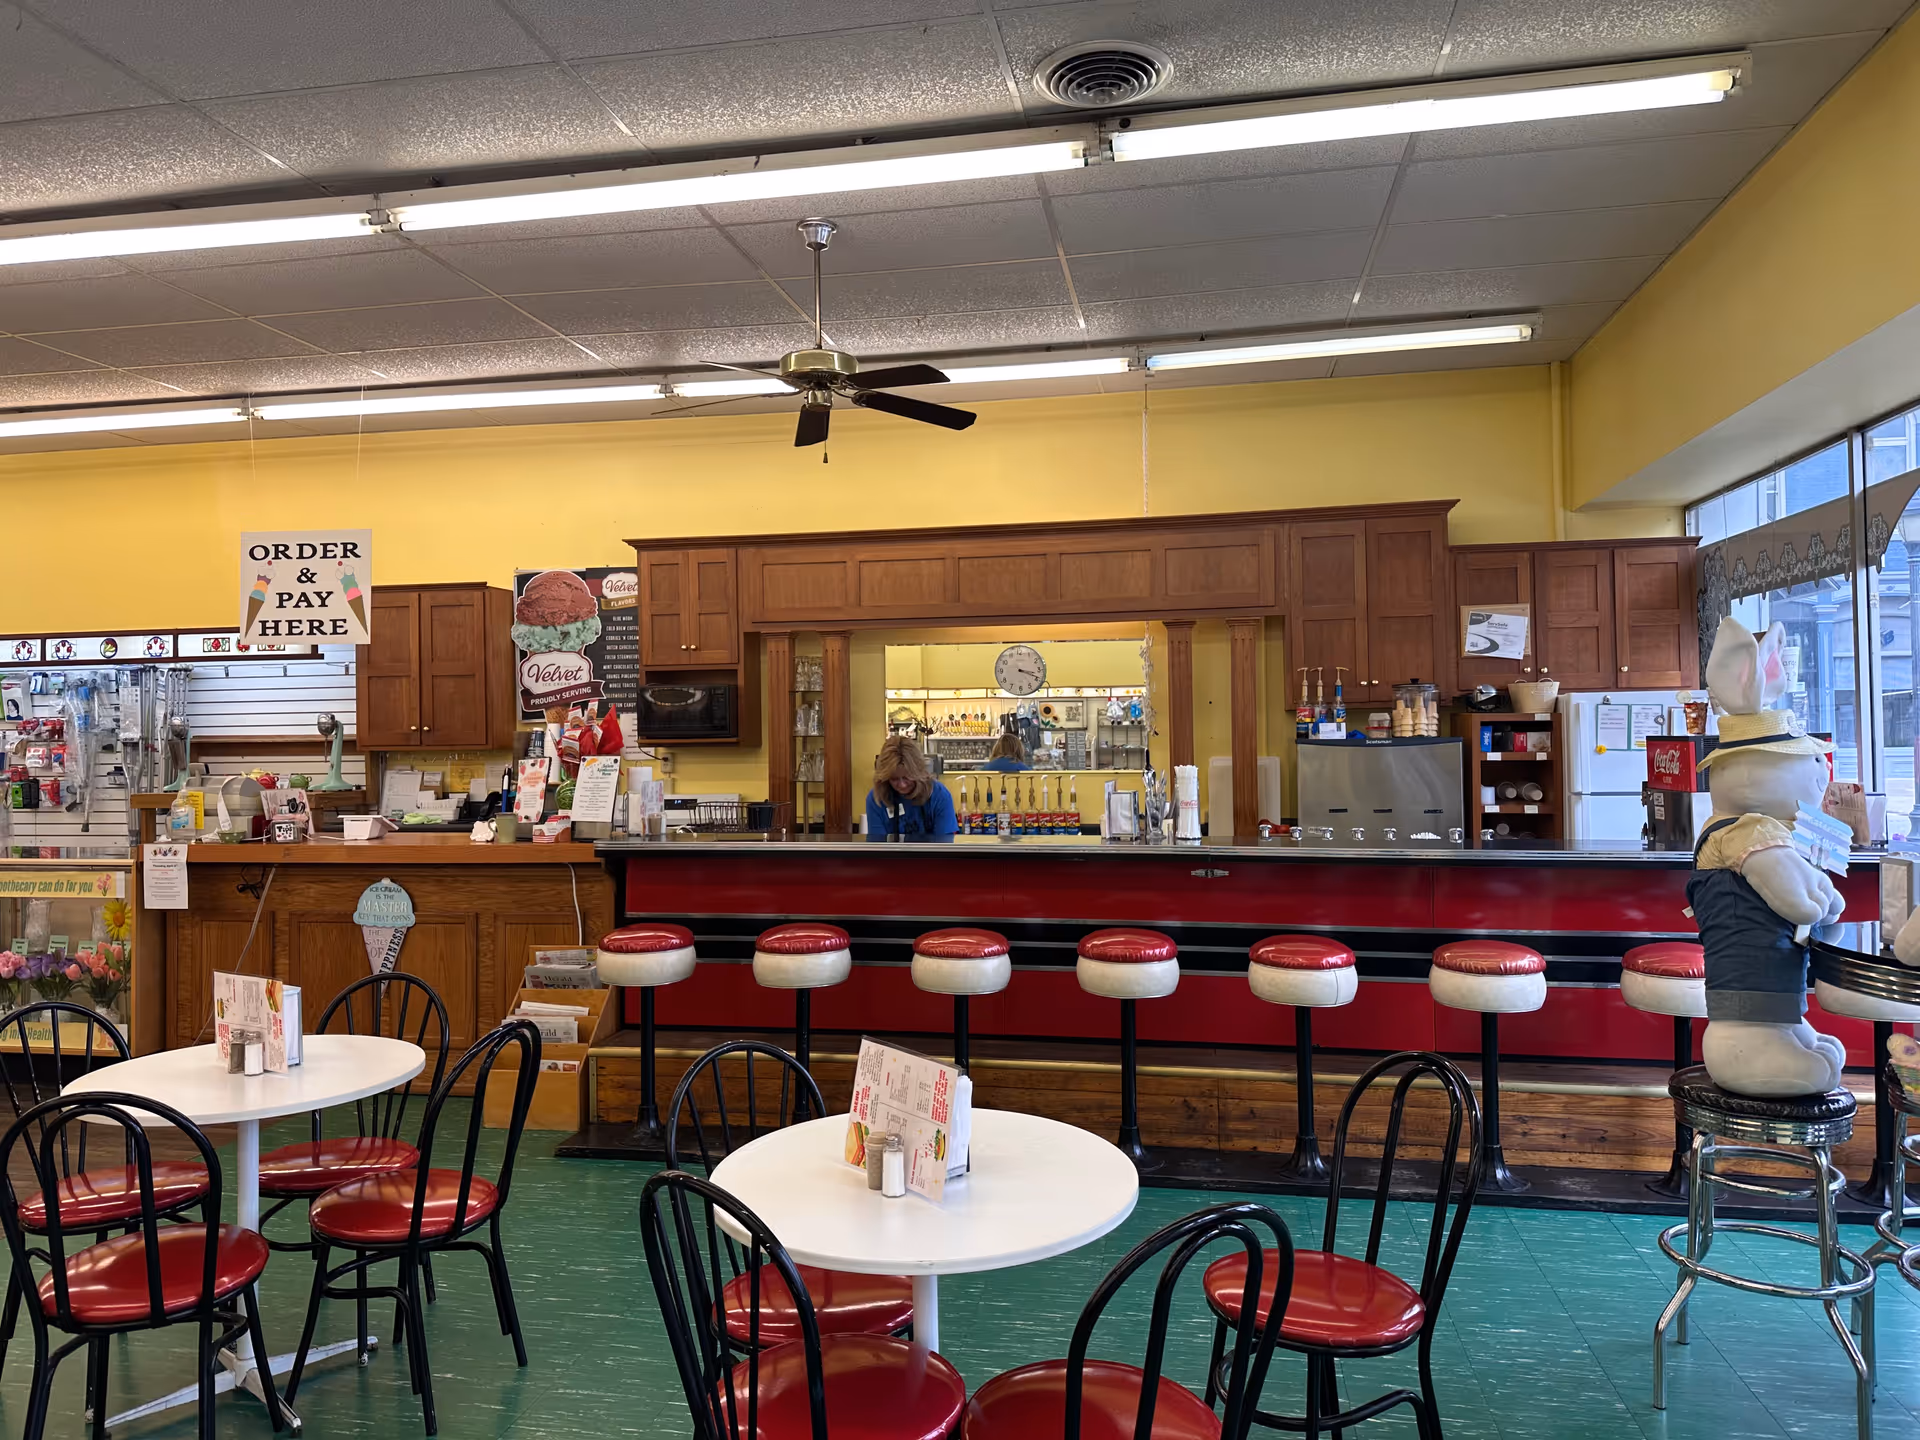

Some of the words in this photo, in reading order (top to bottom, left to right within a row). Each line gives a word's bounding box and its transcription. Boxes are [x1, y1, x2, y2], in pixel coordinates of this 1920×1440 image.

[249, 542, 361, 561] ORDER
[297, 568, 317, 583] &
[606, 580, 638, 592] Velvet
[276, 591, 334, 608] PAY
[611, 598, 636, 606] FLAVORS
[259, 619, 348, 636] HERE
[528, 664, 583, 683] Velvet
[530, 694, 560, 706] PROUDLY
[562, 687, 591, 698] SERVING
[1654, 748, 1681, 775] Coca-Cola
[38, 881, 53, 892] can
[54, 879, 64, 892] do
[66, 880, 77, 892] for
[77, 882, 93, 895] you
[363, 899, 408, 913] MASTER
[373, 914, 389, 922] THAT
[370, 947, 385, 959] OF
[379, 928, 404, 977] PPINESS
